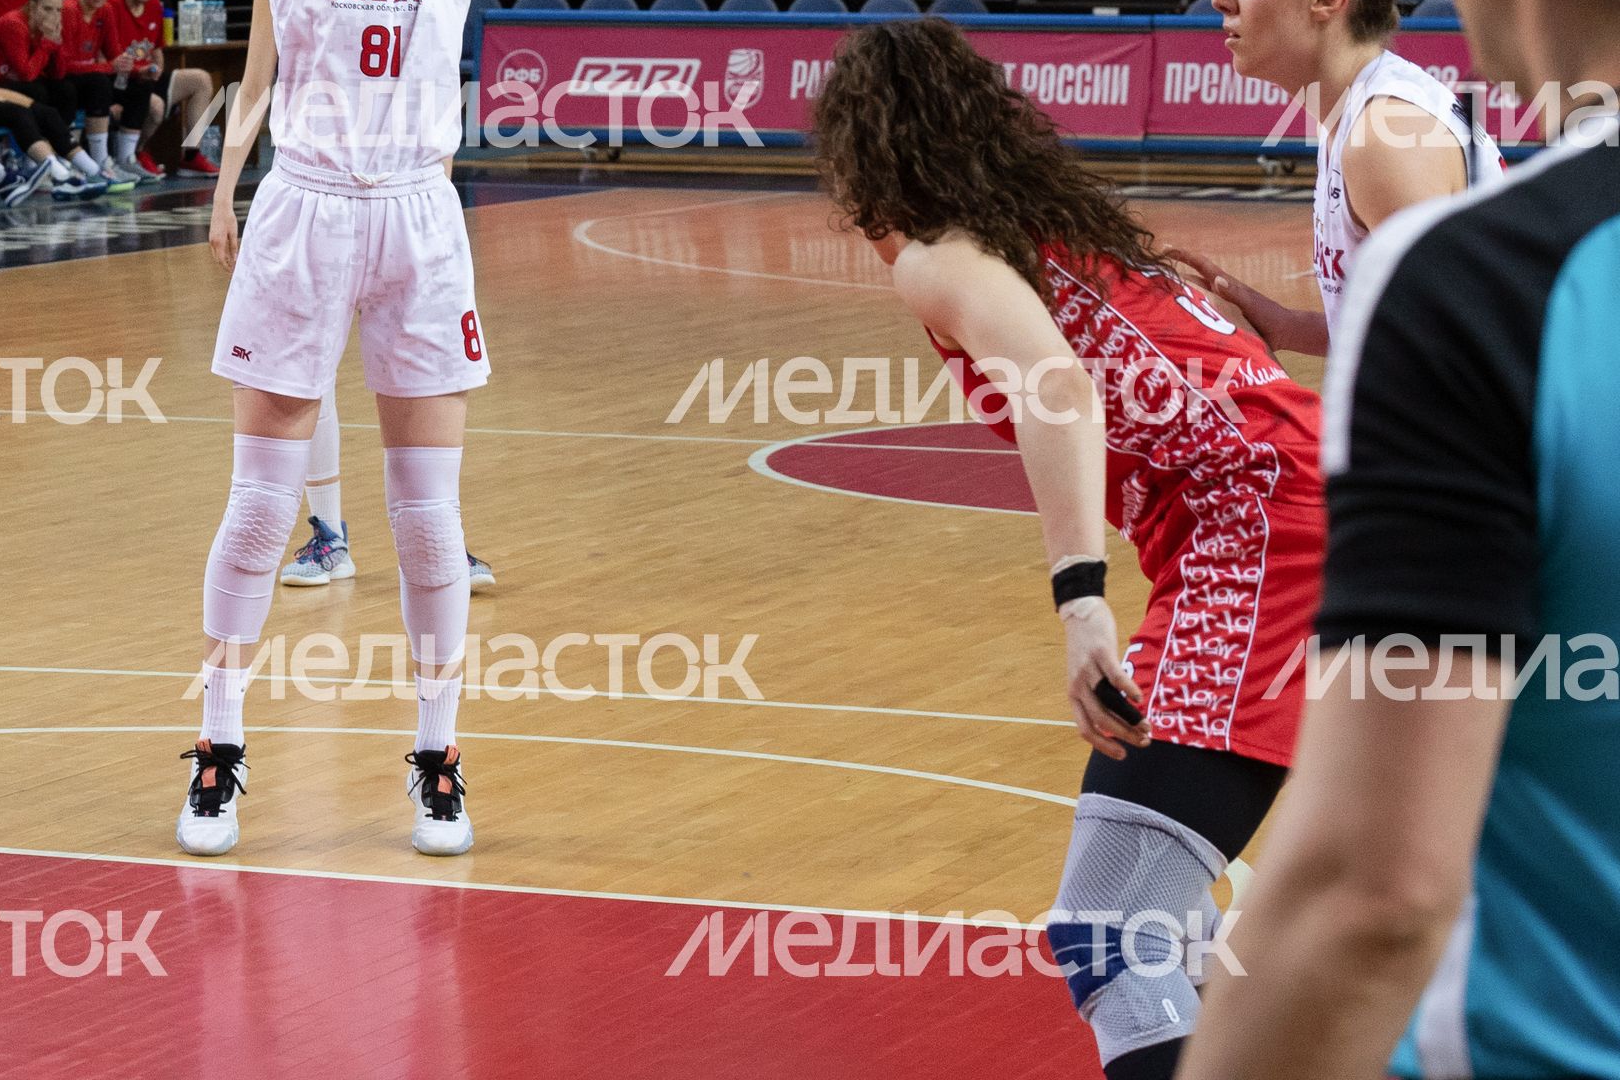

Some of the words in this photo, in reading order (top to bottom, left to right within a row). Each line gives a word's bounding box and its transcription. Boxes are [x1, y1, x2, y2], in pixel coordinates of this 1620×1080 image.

[359, 24, 402, 78] 81
[503, 67, 542, 83] РФБ
[460, 309, 482, 362] 8
